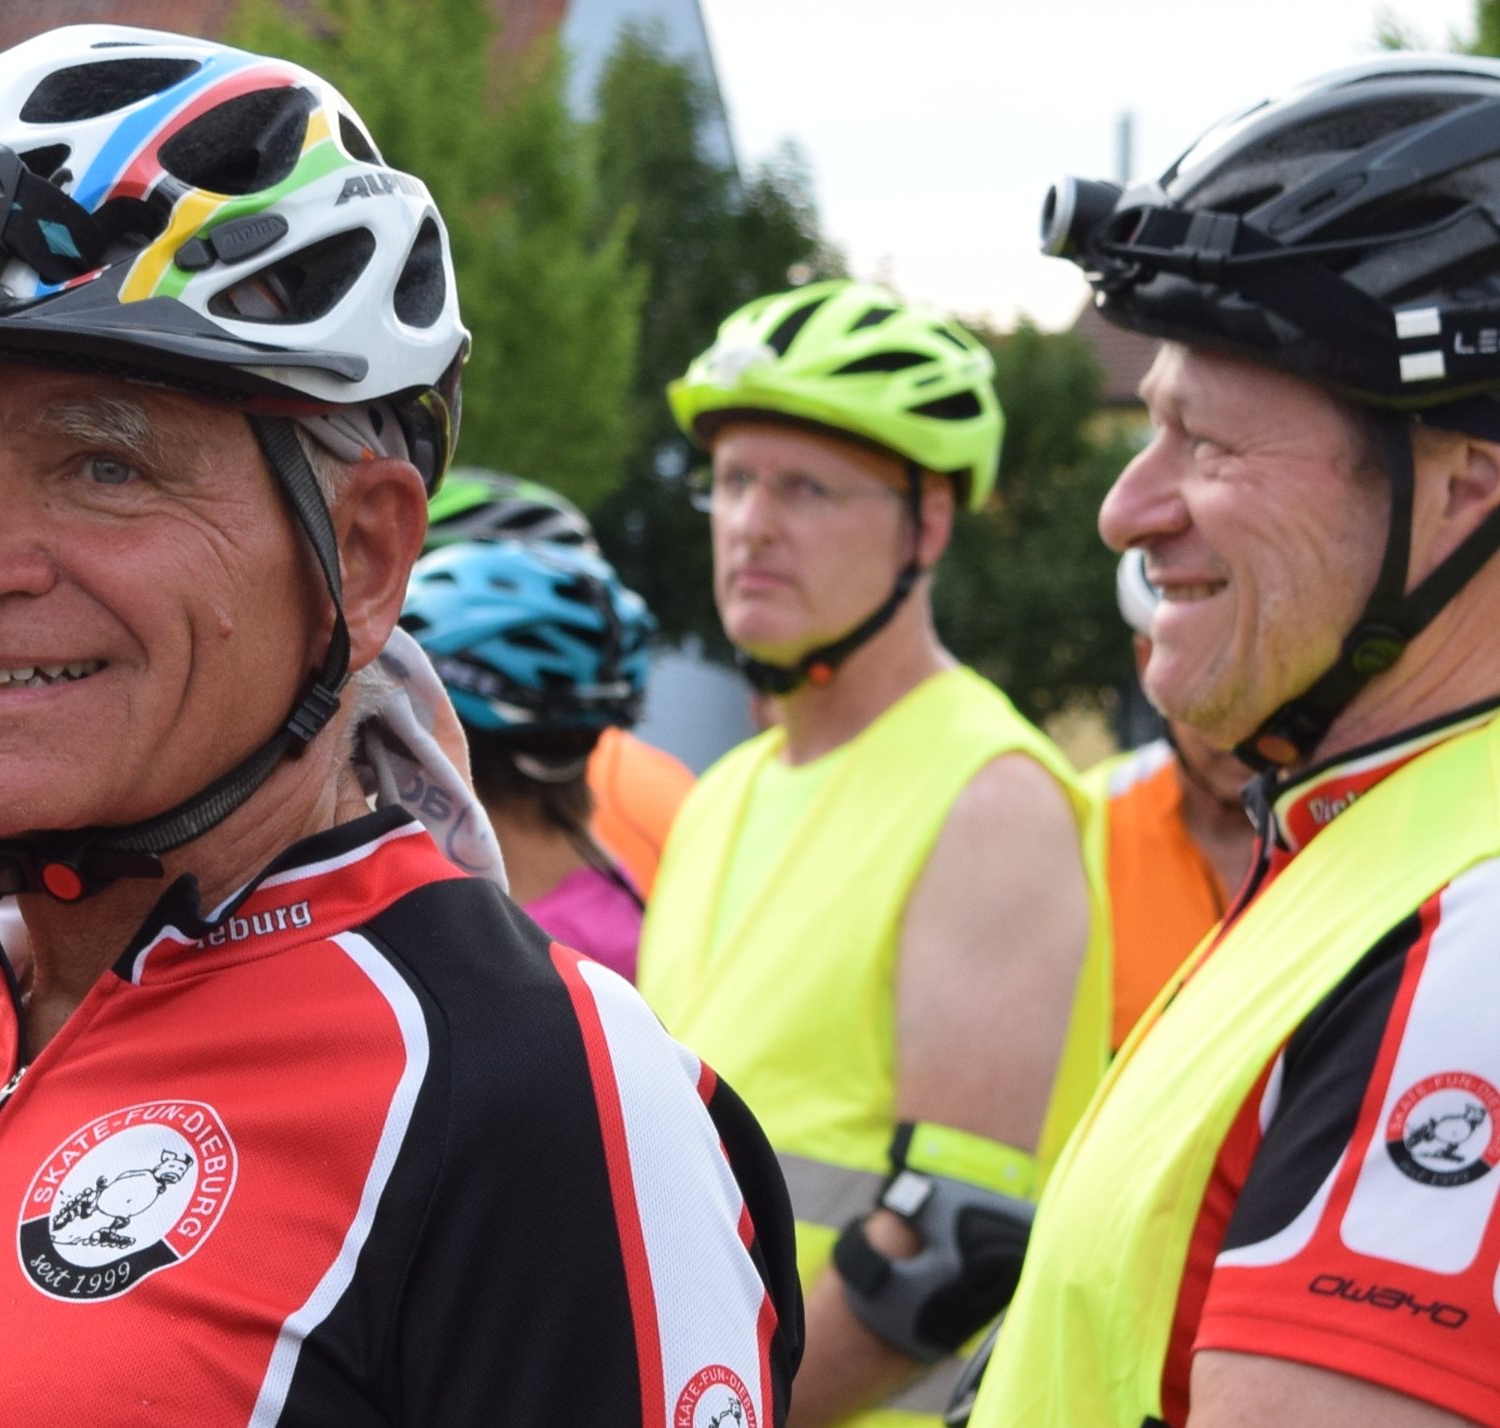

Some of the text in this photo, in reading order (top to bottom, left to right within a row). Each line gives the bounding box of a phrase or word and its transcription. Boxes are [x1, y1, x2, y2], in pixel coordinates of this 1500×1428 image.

[1454, 329, 1500, 355] LE
[30, 1254, 130, 1294] seit 1999
